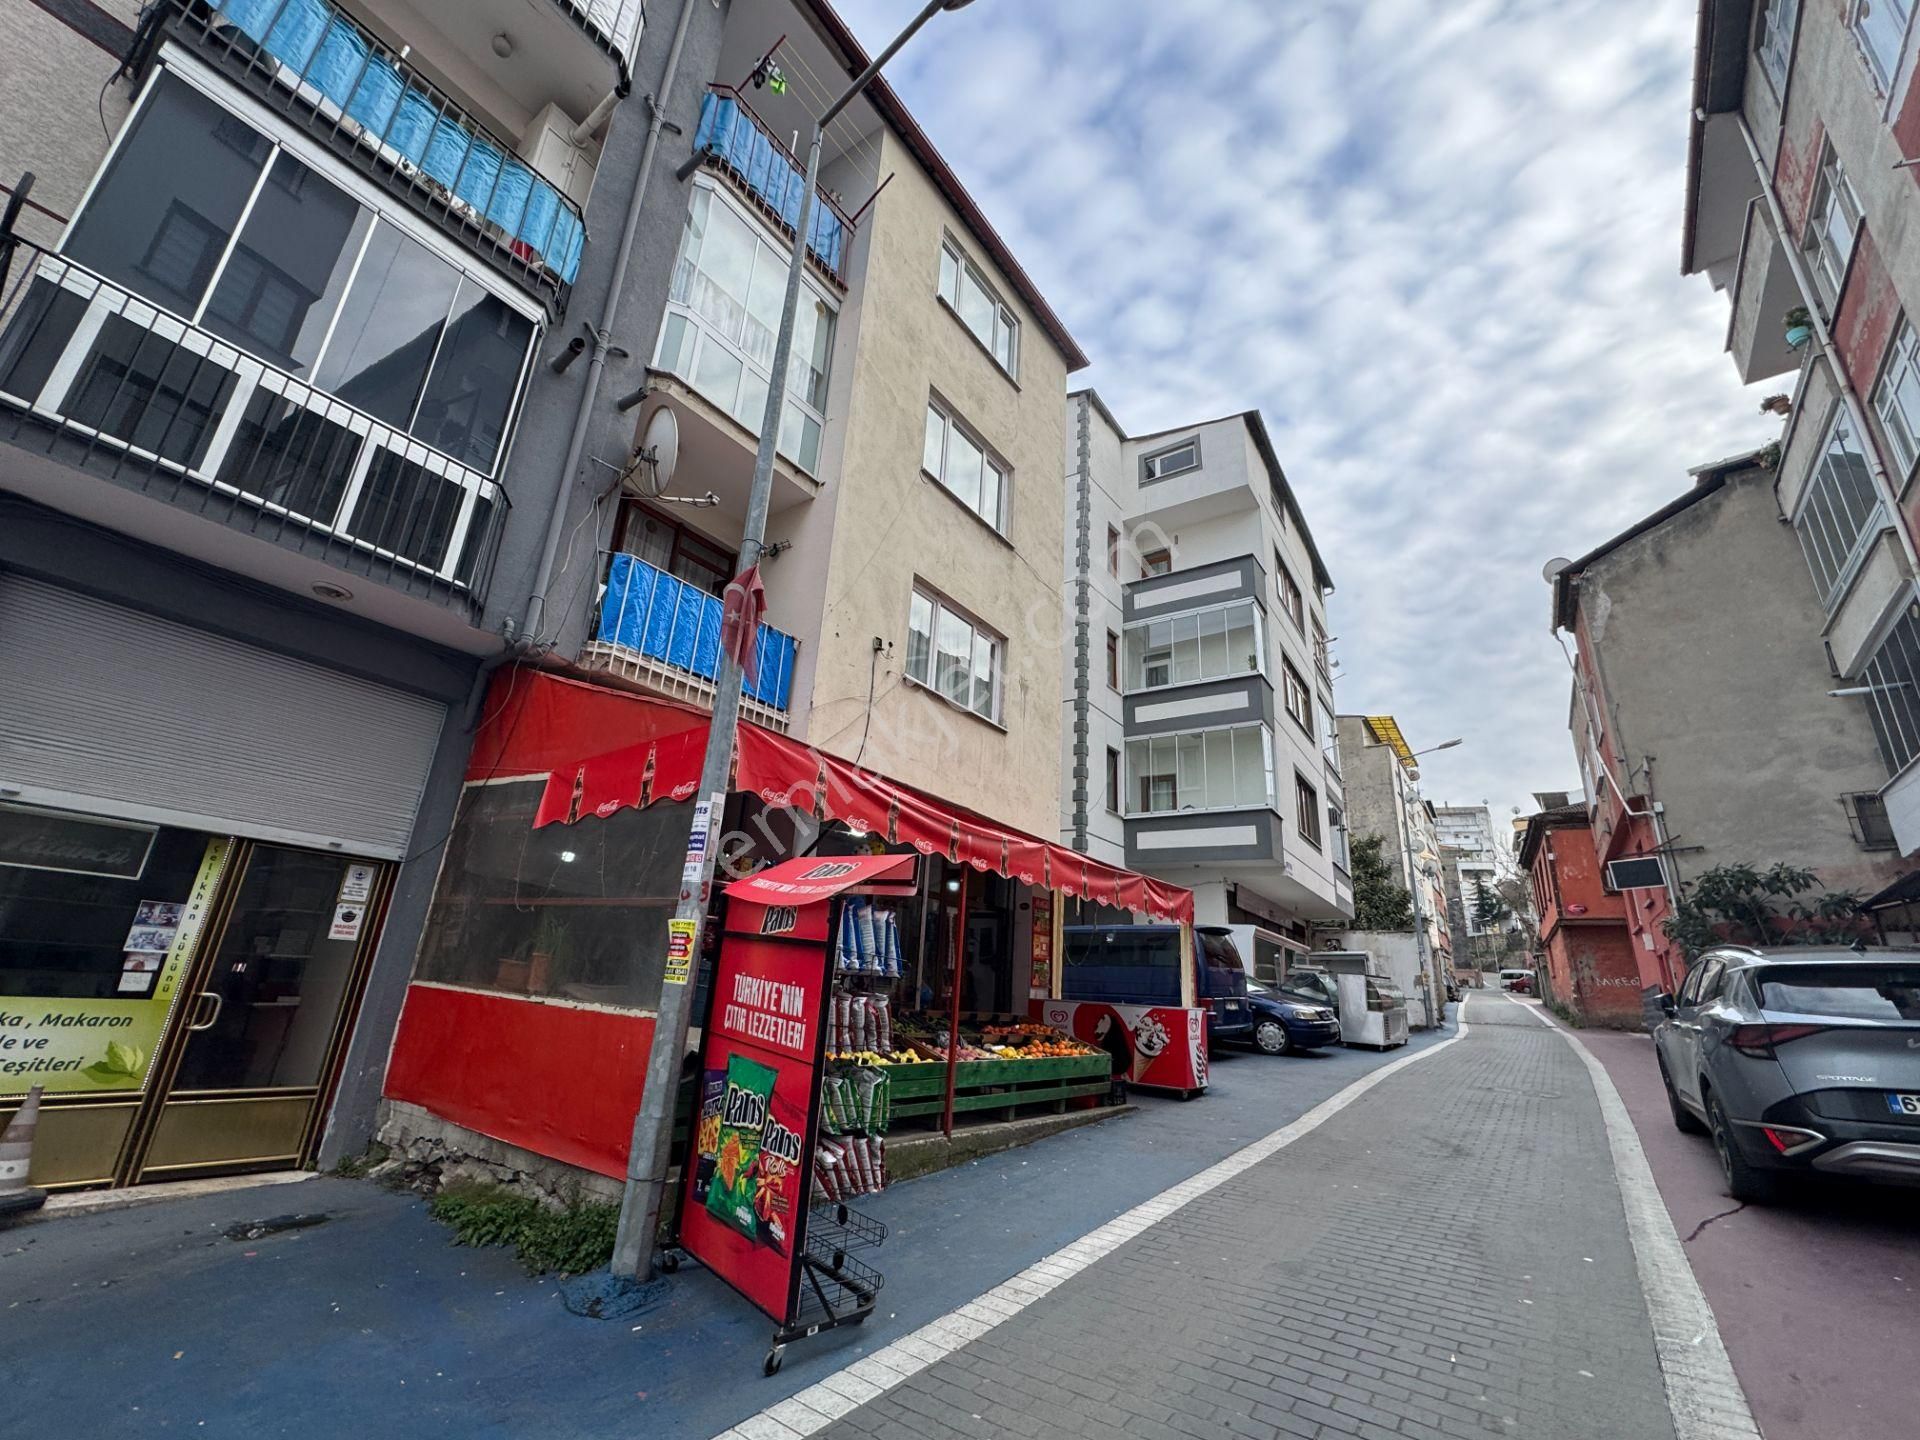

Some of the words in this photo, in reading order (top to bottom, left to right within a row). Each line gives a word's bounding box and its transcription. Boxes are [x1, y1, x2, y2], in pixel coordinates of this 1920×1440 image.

[733, 971, 805, 1018] TÜRKİYE'NİN
[39, 1012, 134, 1028] Makaron
[724, 1004, 747, 1033] ÇITIR
[748, 1010, 806, 1052] LEZZETLERİ
[23, 1038, 49, 1050] ve
